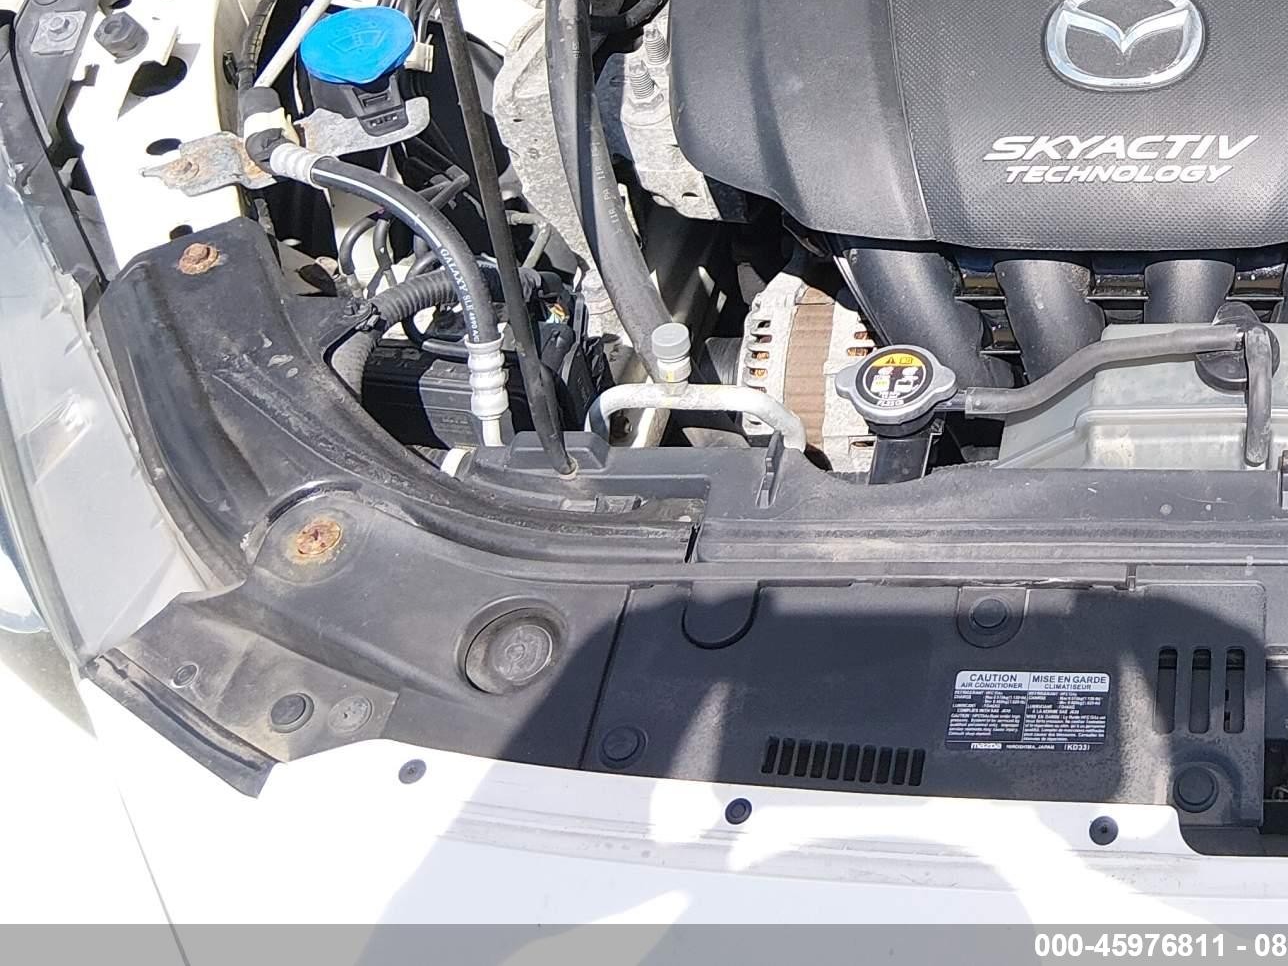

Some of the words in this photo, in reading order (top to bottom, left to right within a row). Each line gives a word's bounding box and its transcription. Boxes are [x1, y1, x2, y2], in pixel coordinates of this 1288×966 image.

[982, 134, 1259, 162] SKYACTIV
[1005, 165, 1234, 184] TECHNOLOGY
[440, 248, 468, 292] GALAXY
[463, 295, 474, 310] SLE
[969, 673, 1017, 682] CAUTION
[1032, 675, 1056, 683] MISE
[1058, 675, 1071, 683] EN
[1072, 676, 1107, 684] GARDE
